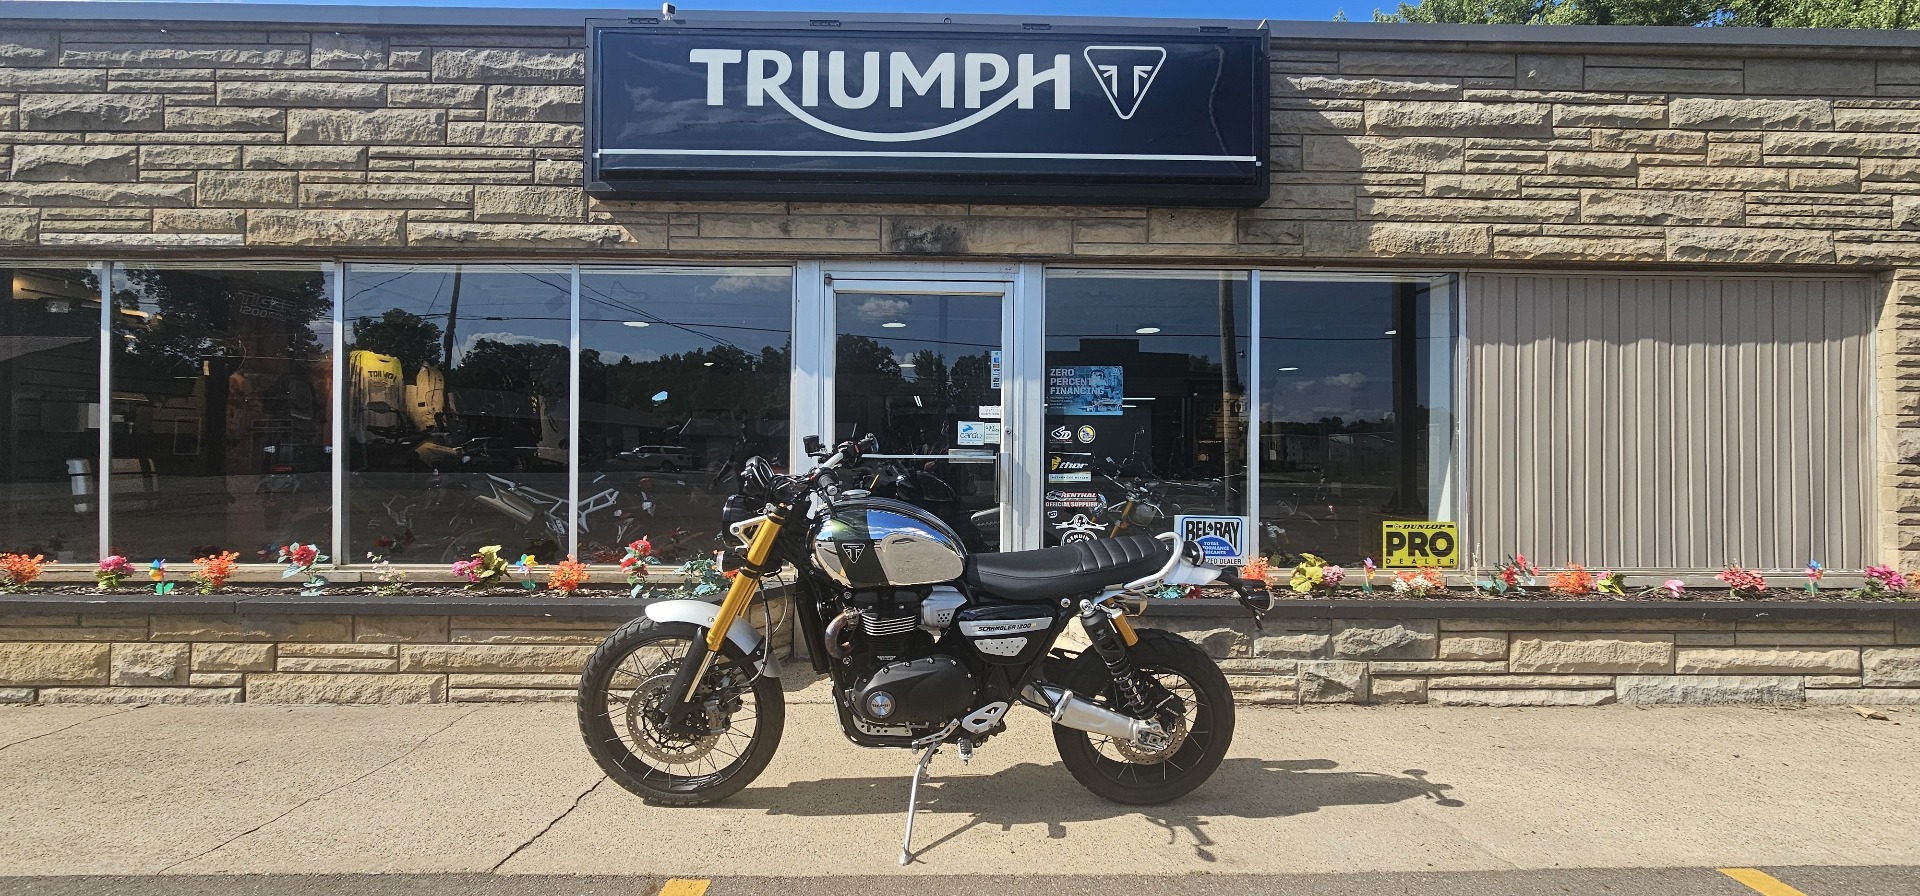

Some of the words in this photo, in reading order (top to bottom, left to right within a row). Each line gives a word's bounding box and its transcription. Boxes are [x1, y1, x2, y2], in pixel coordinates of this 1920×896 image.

[689, 48, 1071, 142] TRIUMPH
[1050, 368, 1075, 377] ZERO
[1050, 377, 1092, 386] PERCENT
[1050, 386, 1105, 395] FINANCING
[1066, 533, 1091, 544] GENUIN
[1386, 531, 1455, 558] PRO
